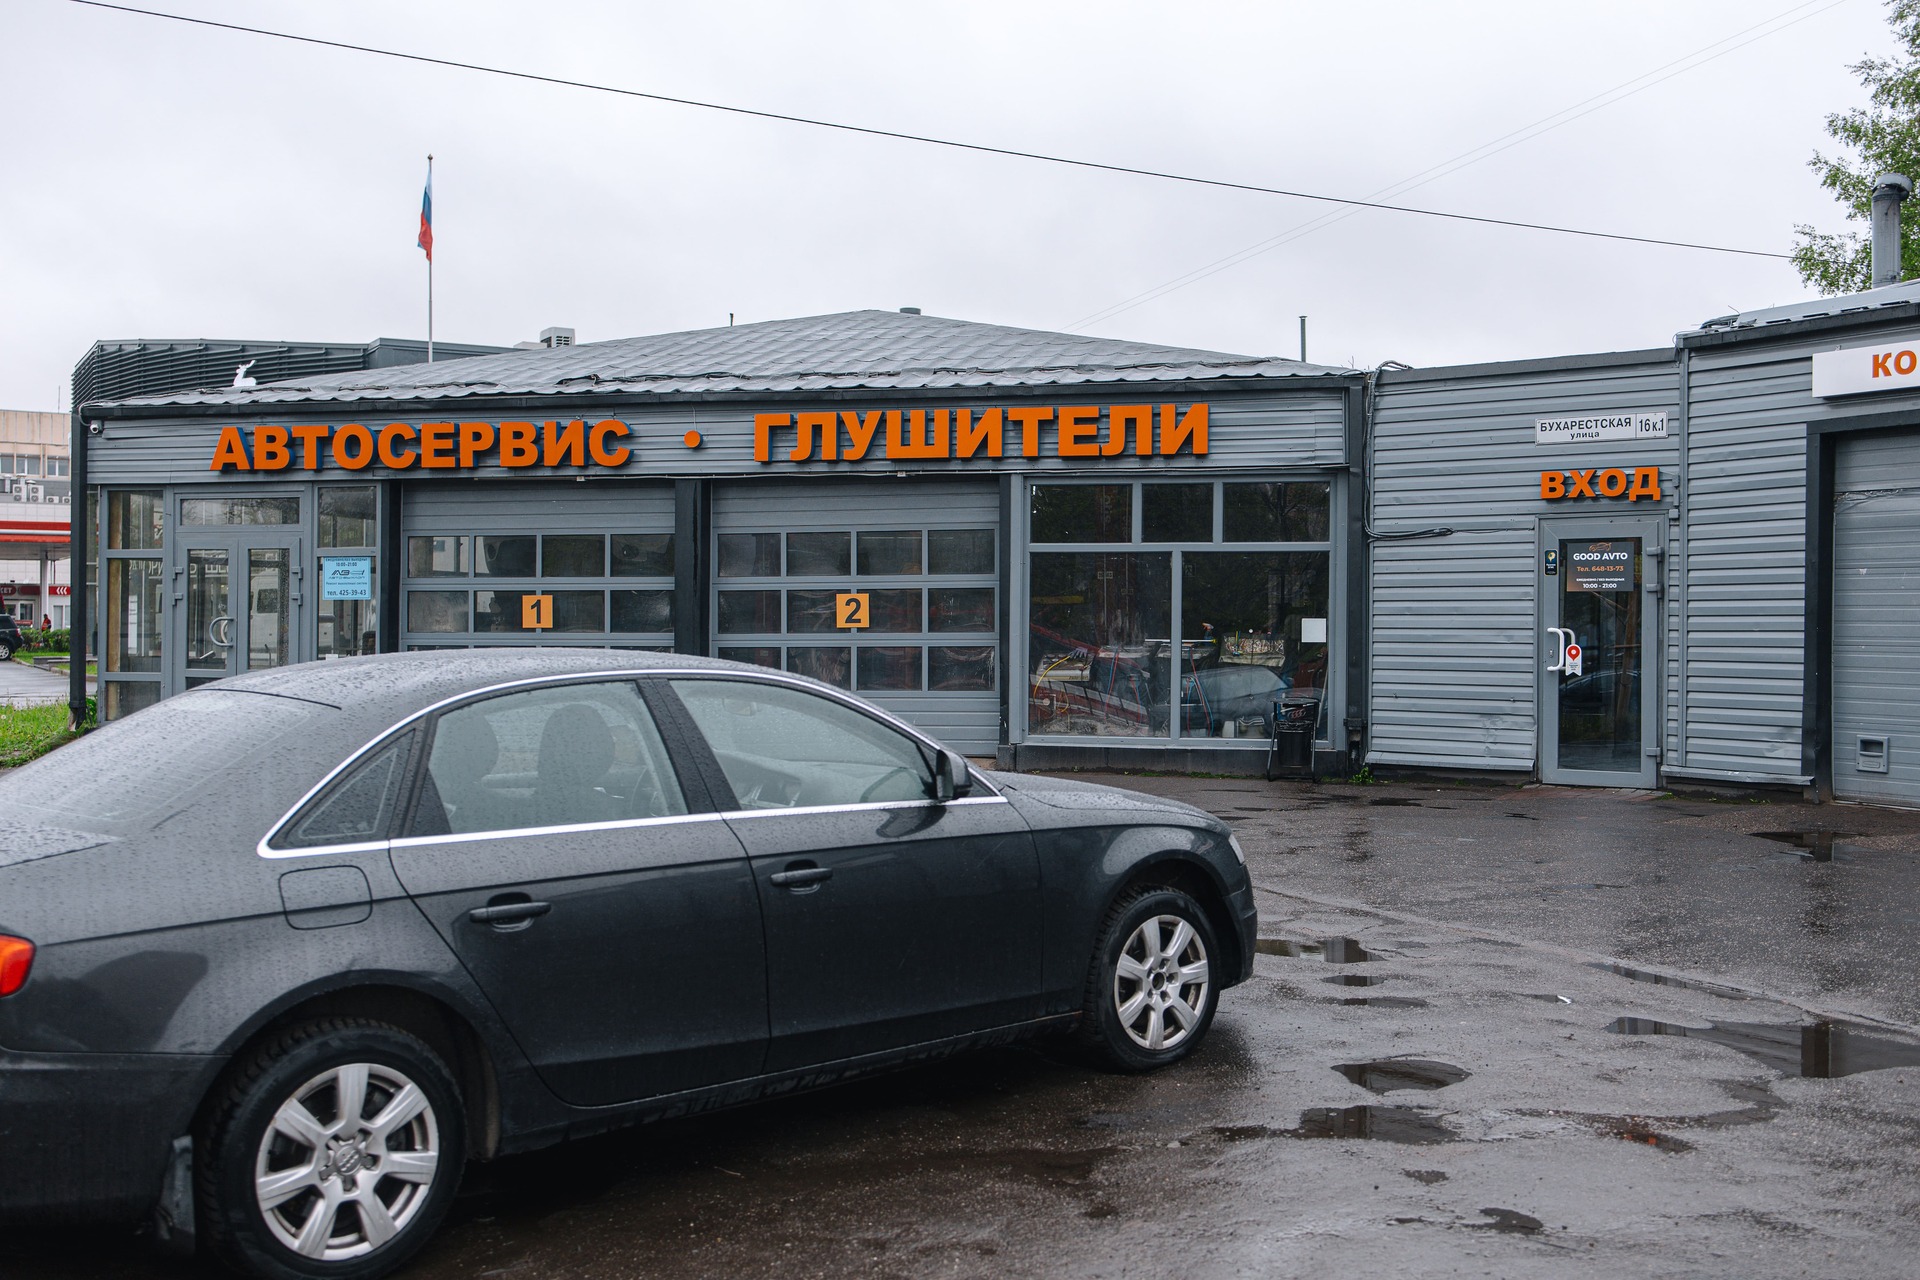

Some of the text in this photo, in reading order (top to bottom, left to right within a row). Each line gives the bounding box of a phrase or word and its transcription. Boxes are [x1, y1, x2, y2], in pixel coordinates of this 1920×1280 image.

[1872, 350, 1917, 378] КО
[1540, 417, 1631, 431] БУХАРЕСТСКАЯ
[1570, 431, 1600, 440] улица
[209, 403, 1210, 472] АВТОСЕРВИС ГЛУШИТЕЛИ
[1540, 466, 1661, 502] ВХОД
[1573, 552, 1628, 561] GOOD AVTO
[530, 600, 541, 624] 1
[844, 598, 862, 625] 2
